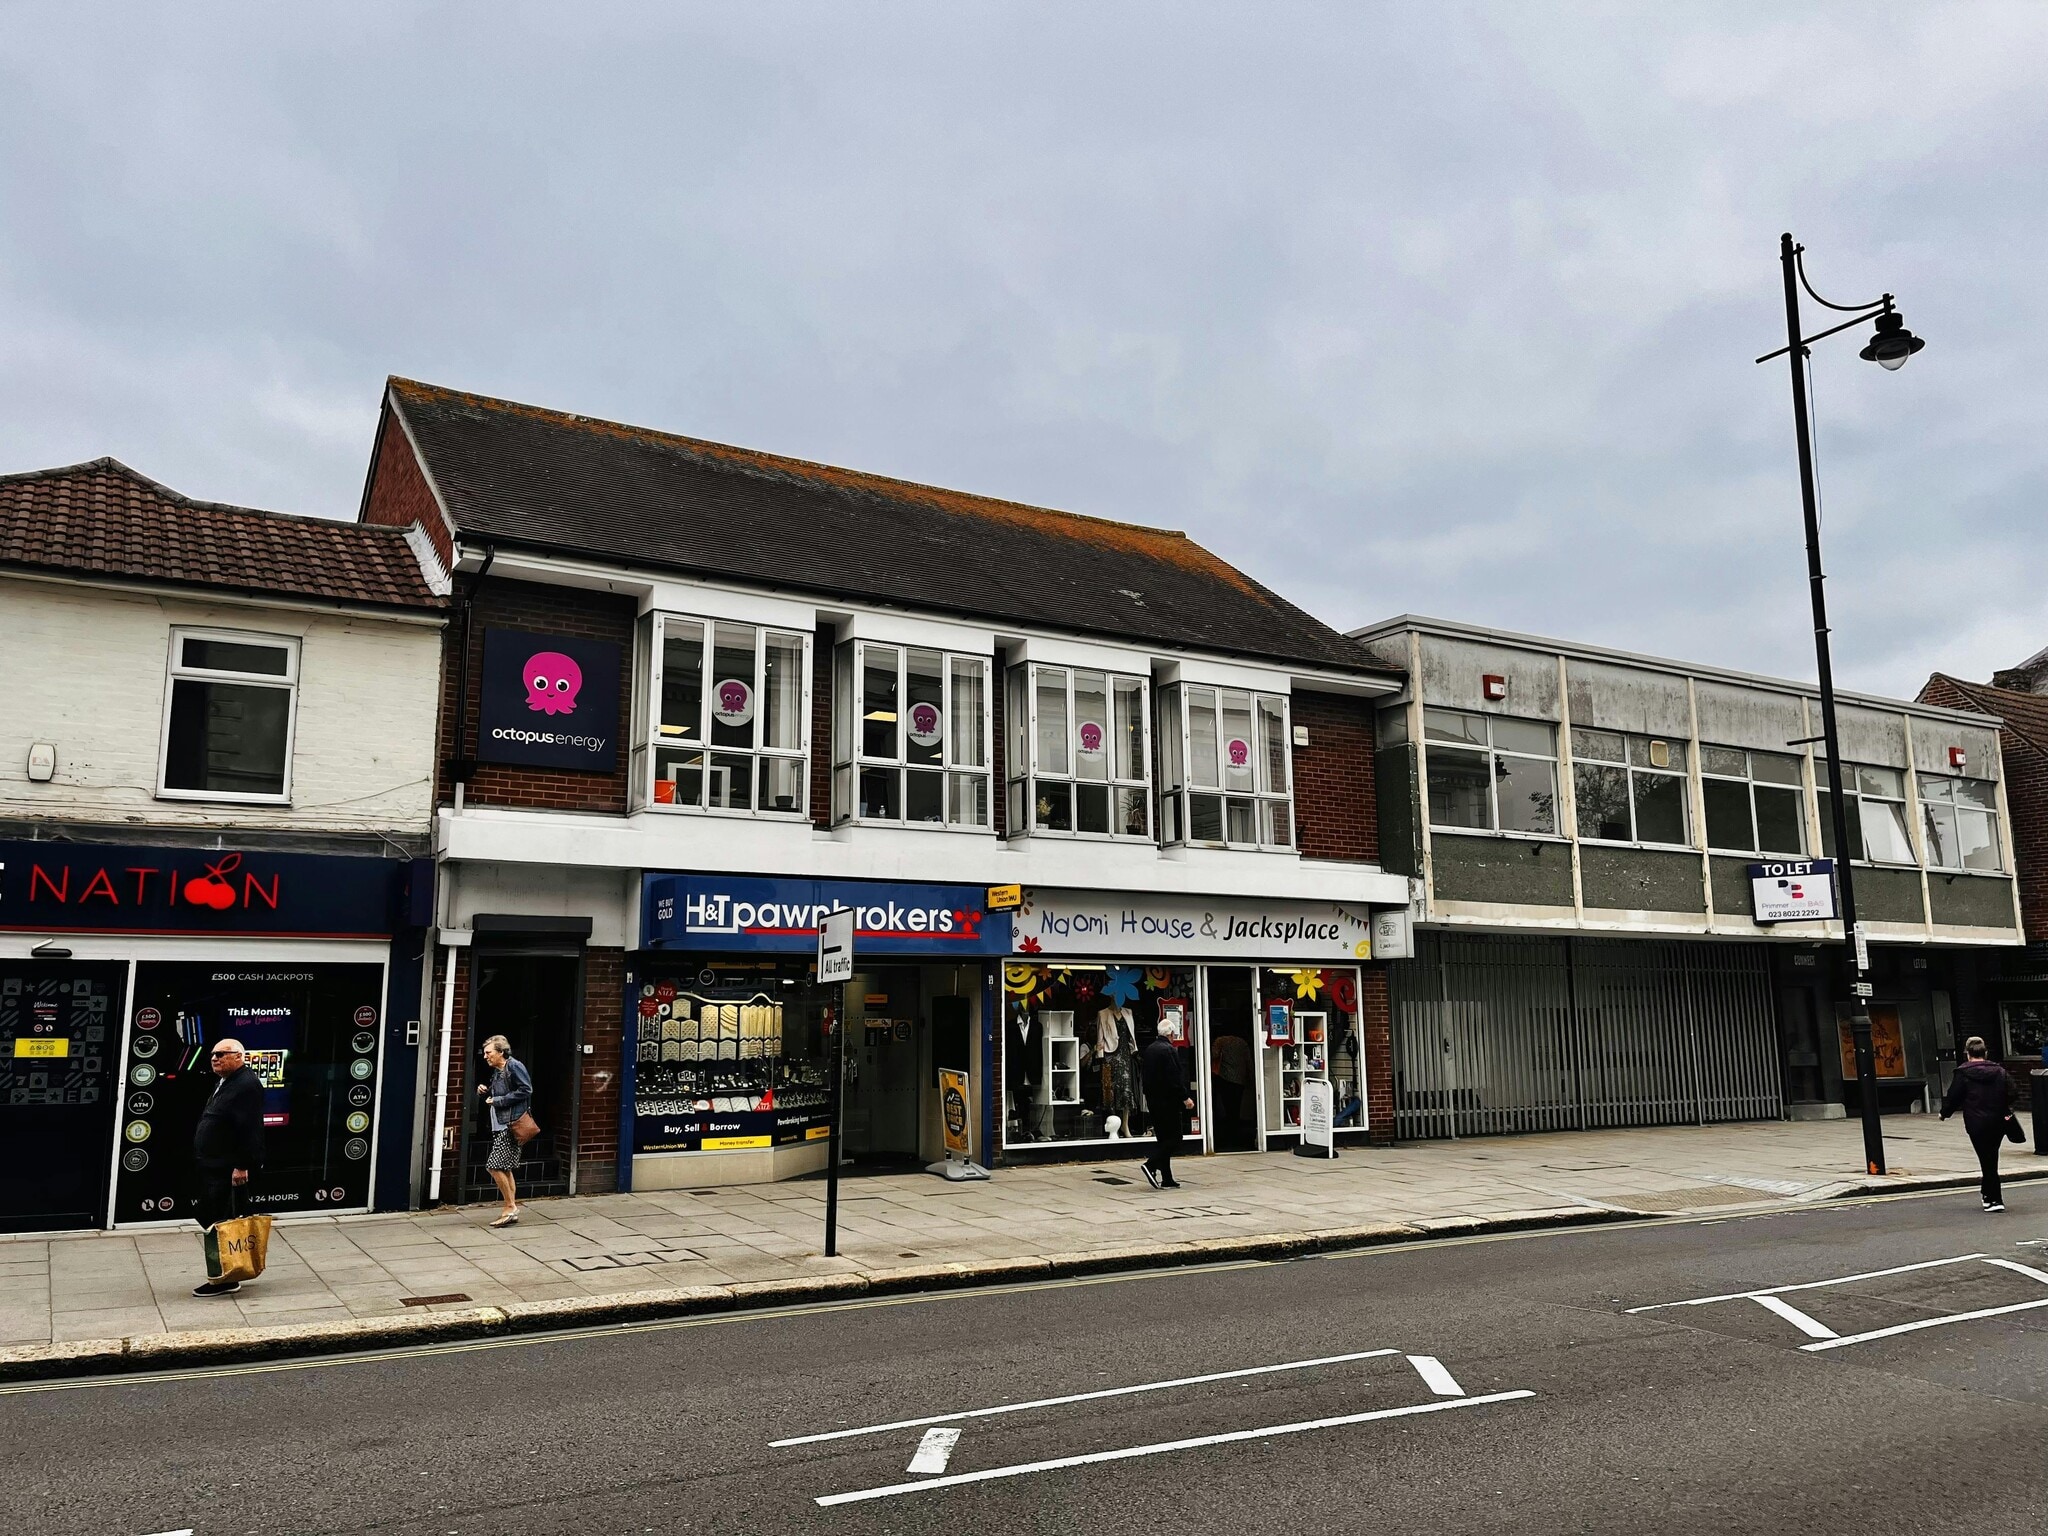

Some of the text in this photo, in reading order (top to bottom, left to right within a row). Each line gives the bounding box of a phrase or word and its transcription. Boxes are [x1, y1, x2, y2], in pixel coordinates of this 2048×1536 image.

[1761, 862, 1813, 876] TO LET
[658, 907, 673, 920] GOLD
[686, 894, 953, 933] H&T pawnrokers
[1041, 909, 1340, 943] Naomi House & Jacksplace
[825, 957, 850, 974] All traffic
[211, 973, 314, 981] £500 CASH JACKPOTS
[228, 1008, 291, 1016] This Month's
[664, 1125, 682, 1134] Buy,
[684, 1123, 699, 1132] Sell
[709, 1123, 741, 1131] Borrow
[267, 1193, 299, 1201] HOURS
